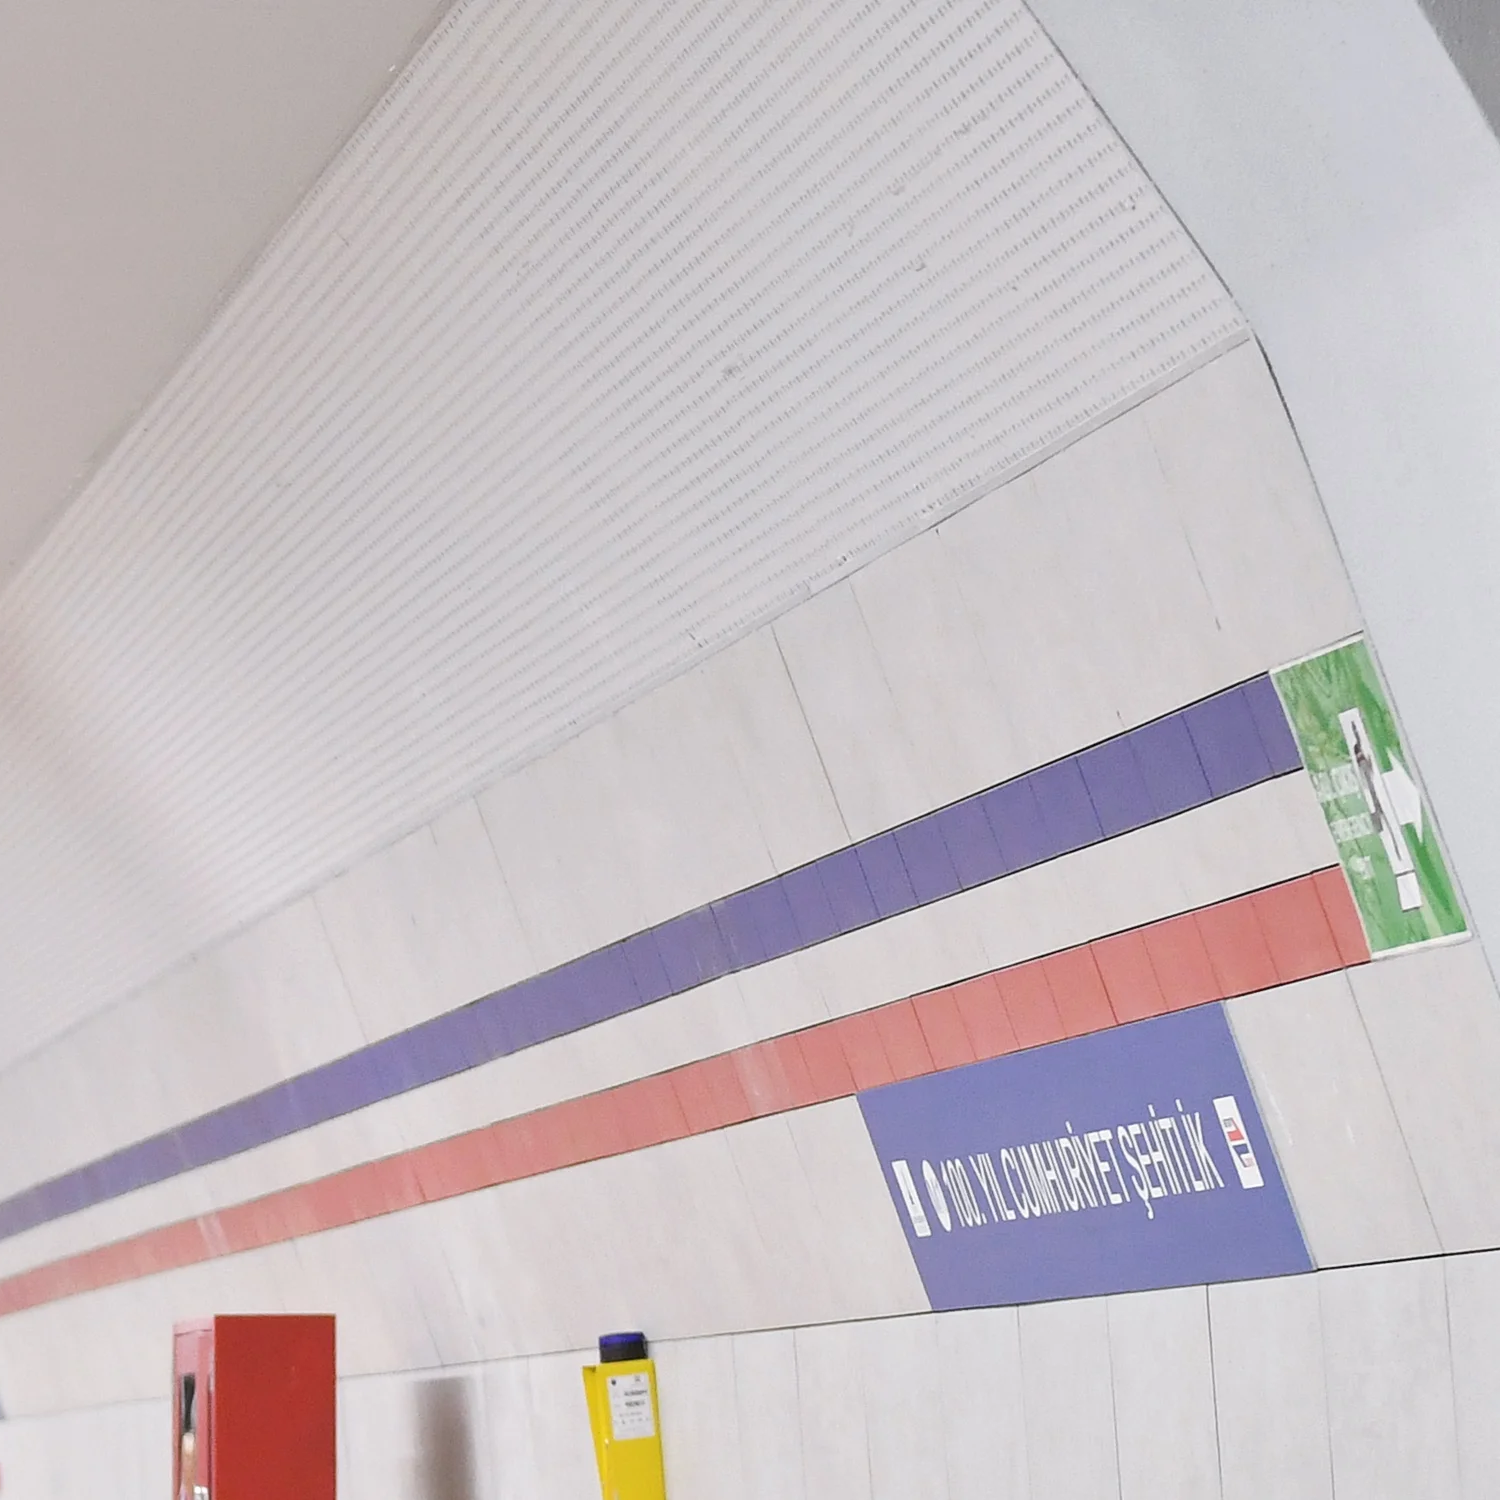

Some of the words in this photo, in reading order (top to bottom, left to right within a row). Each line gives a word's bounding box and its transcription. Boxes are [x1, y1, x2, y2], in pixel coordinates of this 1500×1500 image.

[940, 1157, 987, 1228] 100.
[969, 1152, 1016, 1222] YIL
[1000, 1120, 1131, 1220] CUMHURİYET
[1117, 1098, 1225, 1219] ŞEHİTLİK
